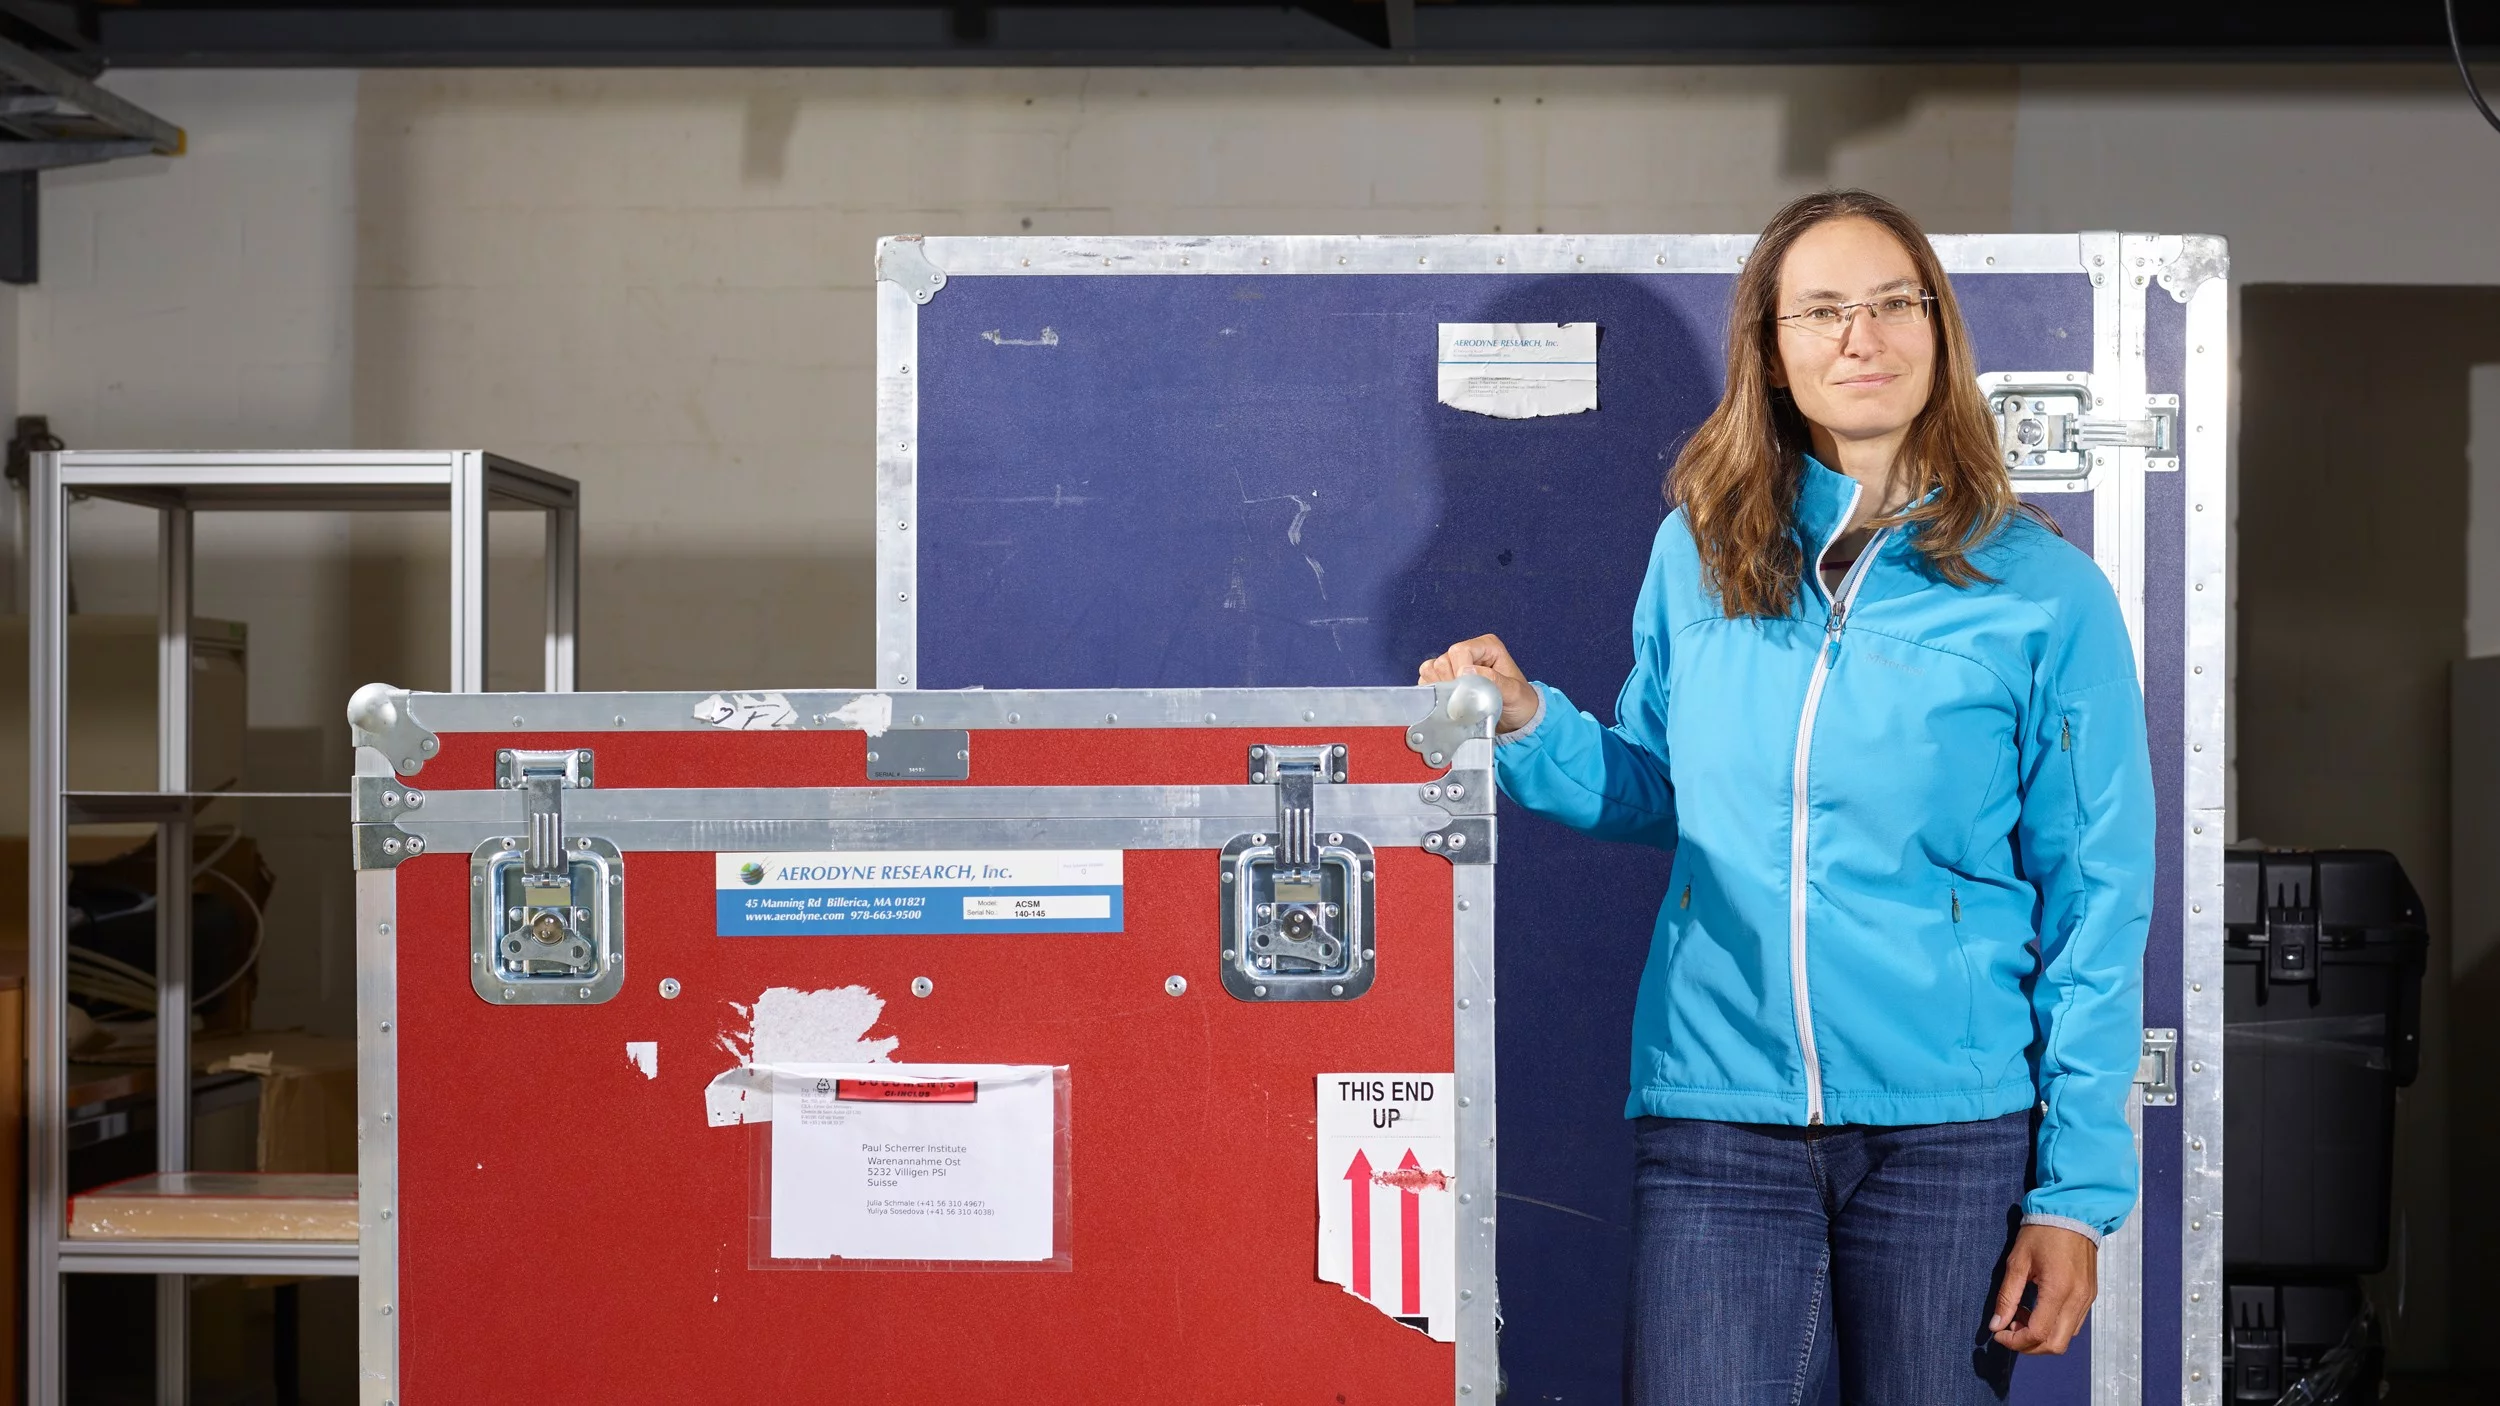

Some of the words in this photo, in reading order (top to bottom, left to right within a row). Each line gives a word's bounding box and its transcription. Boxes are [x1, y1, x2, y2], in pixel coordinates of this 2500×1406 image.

[1454, 339, 1499, 347] AERODYNE
[1500, 339, 1542, 348] RESEARCH,
[1545, 339, 1559, 347] Inc.
[776, 865, 876, 881] AERODYNE
[881, 864, 976, 882] RESEARCH,
[982, 864, 1013, 879] Inc.
[745, 898, 759, 908] 45
[760, 897, 805, 910] Manning
[807, 898, 822, 908] Rd
[826, 897, 871, 909] Billerica,
[873, 897, 892, 907] MA
[894, 896, 926, 907] 01821
[977, 899, 998, 907] Model:
[1015, 900, 1041, 908] ACSM
[745, 910, 845, 922] www.aerodyne.com
[850, 910, 922, 920] 978-663-9500
[1014, 910, 1046, 918] 140-145
[884, 1090, 931, 1098] CI-INCLUS
[1338, 1081, 1385, 1102] THIS
[1391, 1081, 1434, 1102] END
[1372, 1108, 1401, 1129] UP
[862, 1143, 882, 1153] Paul
[884, 1143, 925, 1153] Scherrer
[927, 1144, 967, 1153] Institute
[867, 1157, 943, 1166] Warenannahme
[944, 1157, 961, 1166] Ost
[867, 1168, 892, 1176] 5232
[894, 1168, 929, 1179] Villigen
[932, 1168, 947, 1177] PSI
[867, 1178, 898, 1187] Suisse
[866, 1199, 883, 1208] Julia
[884, 1199, 915, 1207] Schmale
[916, 1199, 934, 1208] (+41
[963, 1200, 985, 1208] 4967)
[867, 1207, 887, 1216] Yuliya
[889, 1207, 924, 1215] Sosedova
[926, 1208, 944, 1216] (+41
[946, 1208, 956, 1216] 56
[958, 1208, 972, 1216] 310
[974, 1208, 995, 1217] 4038)
